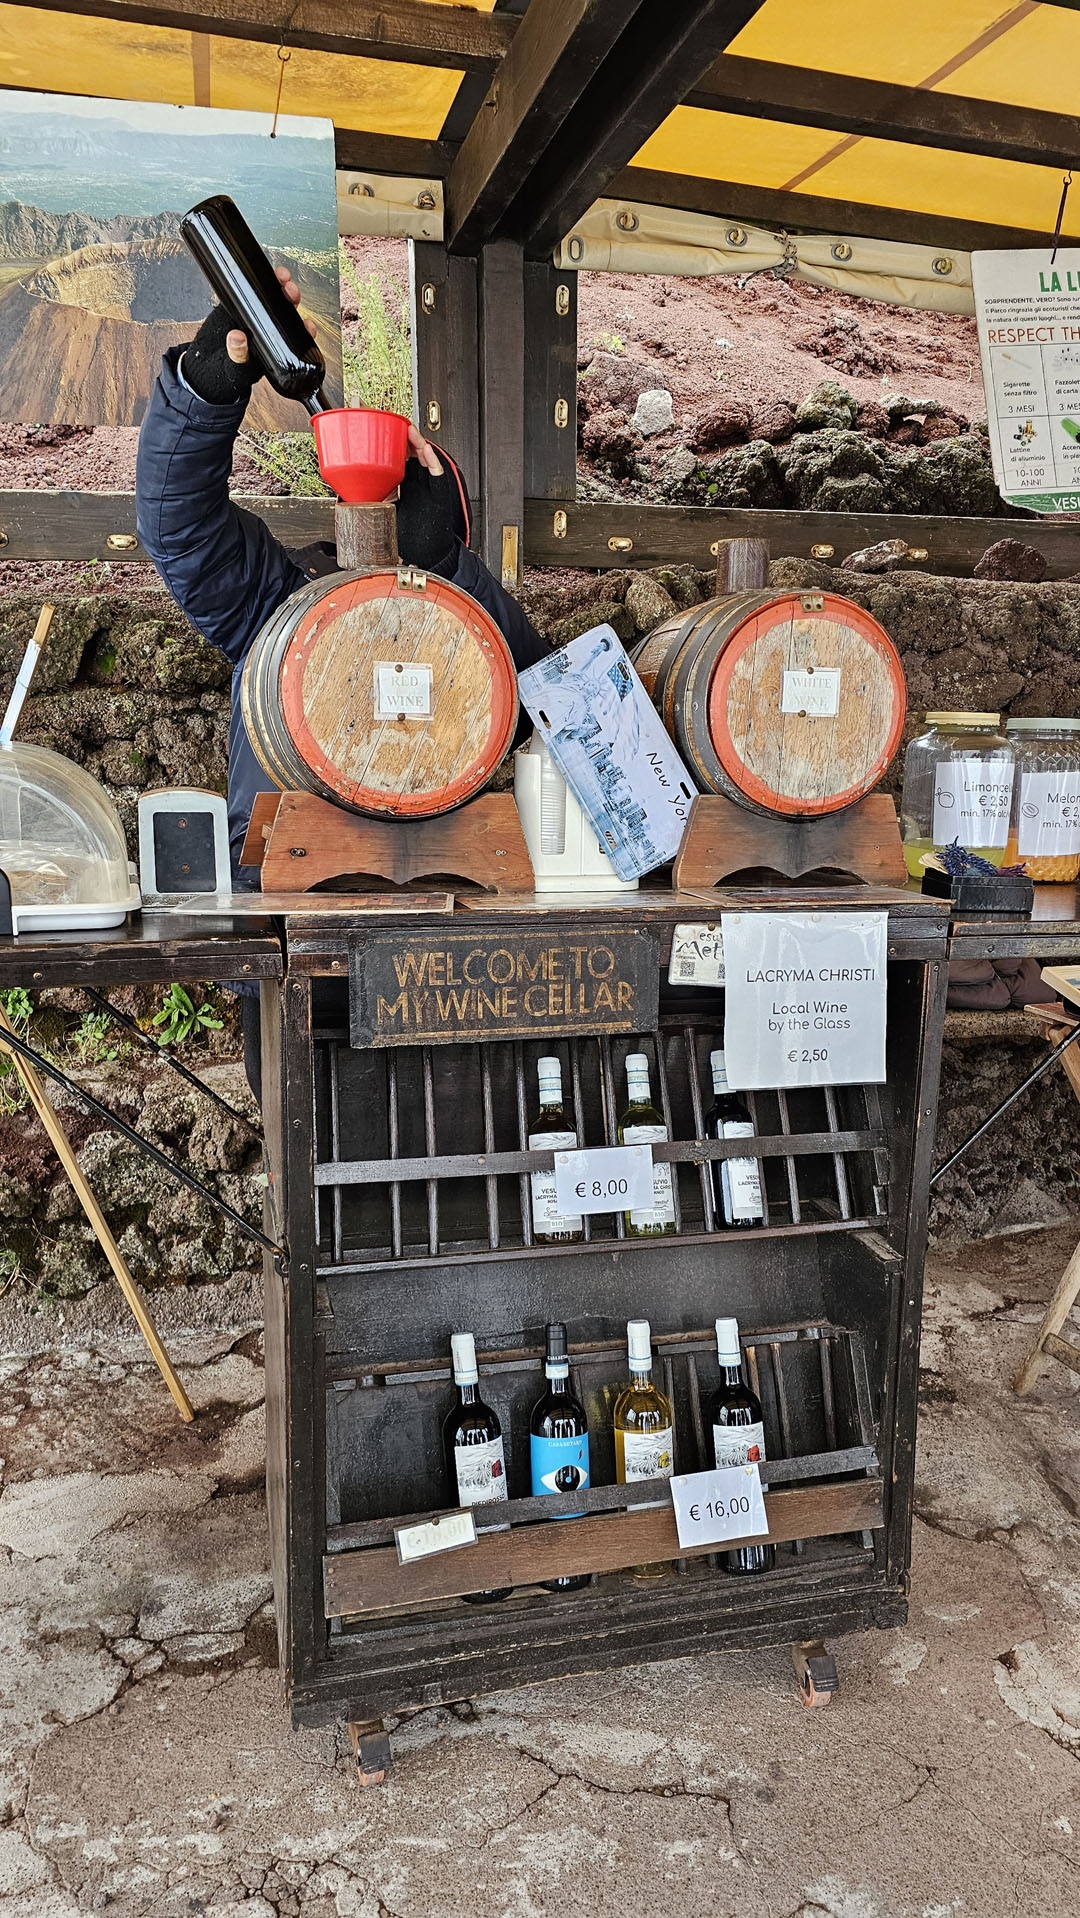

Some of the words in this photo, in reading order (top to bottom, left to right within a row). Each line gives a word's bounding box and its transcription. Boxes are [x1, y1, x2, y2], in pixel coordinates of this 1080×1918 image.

[1039, 271, 1062, 293] LA
[1066, 271, 1080, 292] L
[988, 327, 1055, 343] RESPECT
[1008, 405, 1014, 413] 3
[1016, 405, 1035, 413] MESI
[1059, 403, 1065, 411] 3
[1015, 468, 1045, 478] 10-100
[1021, 479, 1042, 487] ANNI
[391, 675, 419, 687] RED
[792, 677, 832, 689] WHITE
[386, 695, 424, 707] WINE
[645, 752, 671, 787] New
[979, 795, 988, 806] €
[990, 796, 1009, 809] 2,50
[960, 809, 980, 818] min.
[982, 808, 996, 818] 17%
[1062, 806, 1071, 817] €
[1042, 820, 1063, 829] min.
[1065, 819, 1077, 828] 17%
[746, 969, 815, 983] LACRYMA
[818, 968, 875, 982] CHRISTI
[376, 990, 429, 1025] MY
[435, 986, 517, 1021] WINE
[523, 980, 635, 1017] CELLAR
[772, 1002, 810, 1015] Local
[813, 1001, 848, 1014] Wine
[768, 1018, 784, 1034] by
[788, 1018, 810, 1031] the
[813, 1016, 851, 1030] Glass
[787, 1050, 798, 1063] €
[801, 1048, 828, 1064] 2,50
[574, 1182, 586, 1198] €
[592, 1178, 628, 1199] 8,00
[689, 1504, 701, 1522] €
[705, 1496, 750, 1519] 16,00
